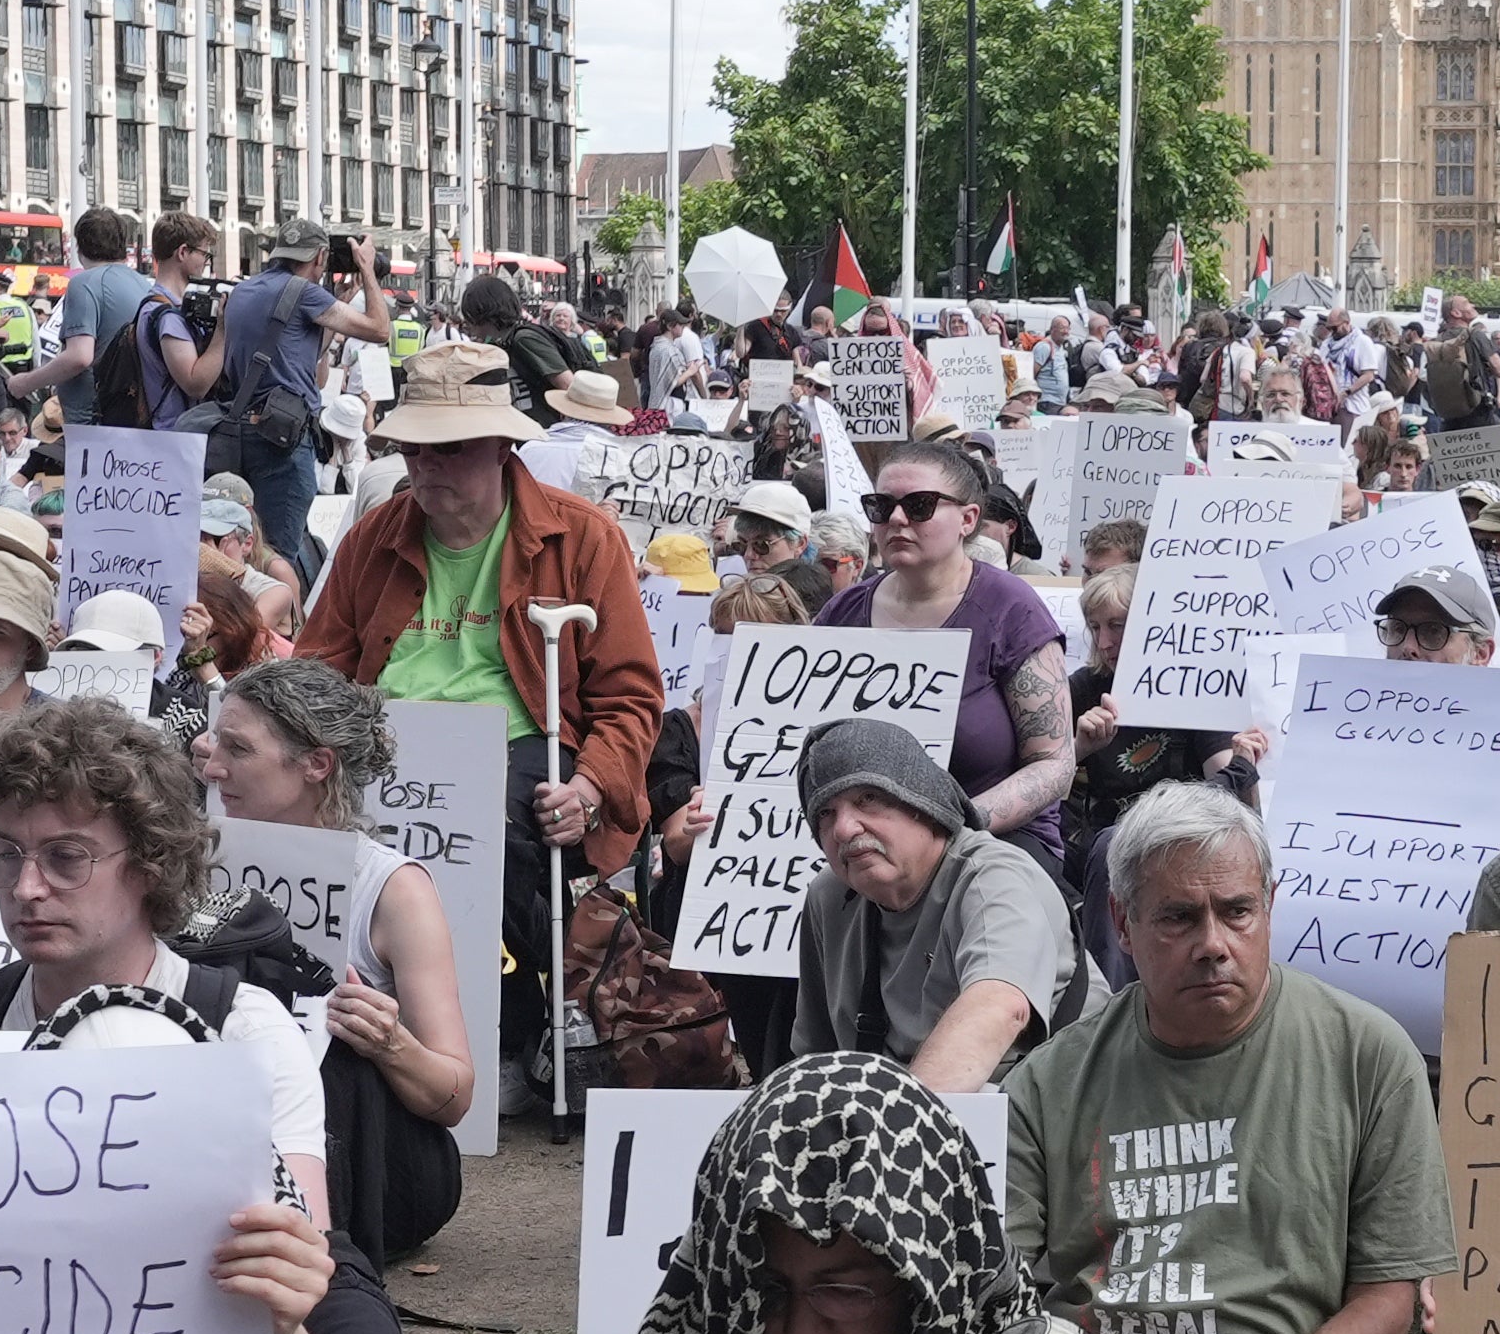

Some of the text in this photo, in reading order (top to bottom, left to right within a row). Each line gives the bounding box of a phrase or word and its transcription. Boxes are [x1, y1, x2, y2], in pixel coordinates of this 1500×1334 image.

[831, 339, 904, 359] I OPPOSE
[831, 358, 902, 375] GENOCIDE
[833, 400, 902, 417] PALESTINE
[845, 383, 904, 401] SUPPORT
[844, 417, 902, 435] ACTION
[1084, 420, 1176, 452] I OPPOSE
[1443, 430, 1481, 445] OPPOSE
[102, 438, 168, 473] OPPOSE
[628, 442, 756, 489] OPPOSE
[1451, 453, 1496, 470] SUPPORT
[75, 484, 182, 516] GENOCIDE
[1201, 498, 1293, 524] OPPOSE
[88, 550, 162, 578] SUPPORT
[1309, 519, 1444, 586] OPPOSE
[763, 645, 959, 715] OPPOSE
[1132, 664, 1248, 700] ACTION
[1303, 679, 1471, 717] I OPPOSE
[1279, 821, 1311, 851] I
[1272, 866, 1474, 917] PALESTIN
[1480, 962, 1492, 1066] I
[1108, 1116, 1237, 1173] THINK
[1109, 1163, 1239, 1220] WHILE
[1116, 1222, 1183, 1269] IT'S
[1098, 1263, 1214, 1305] STILL
